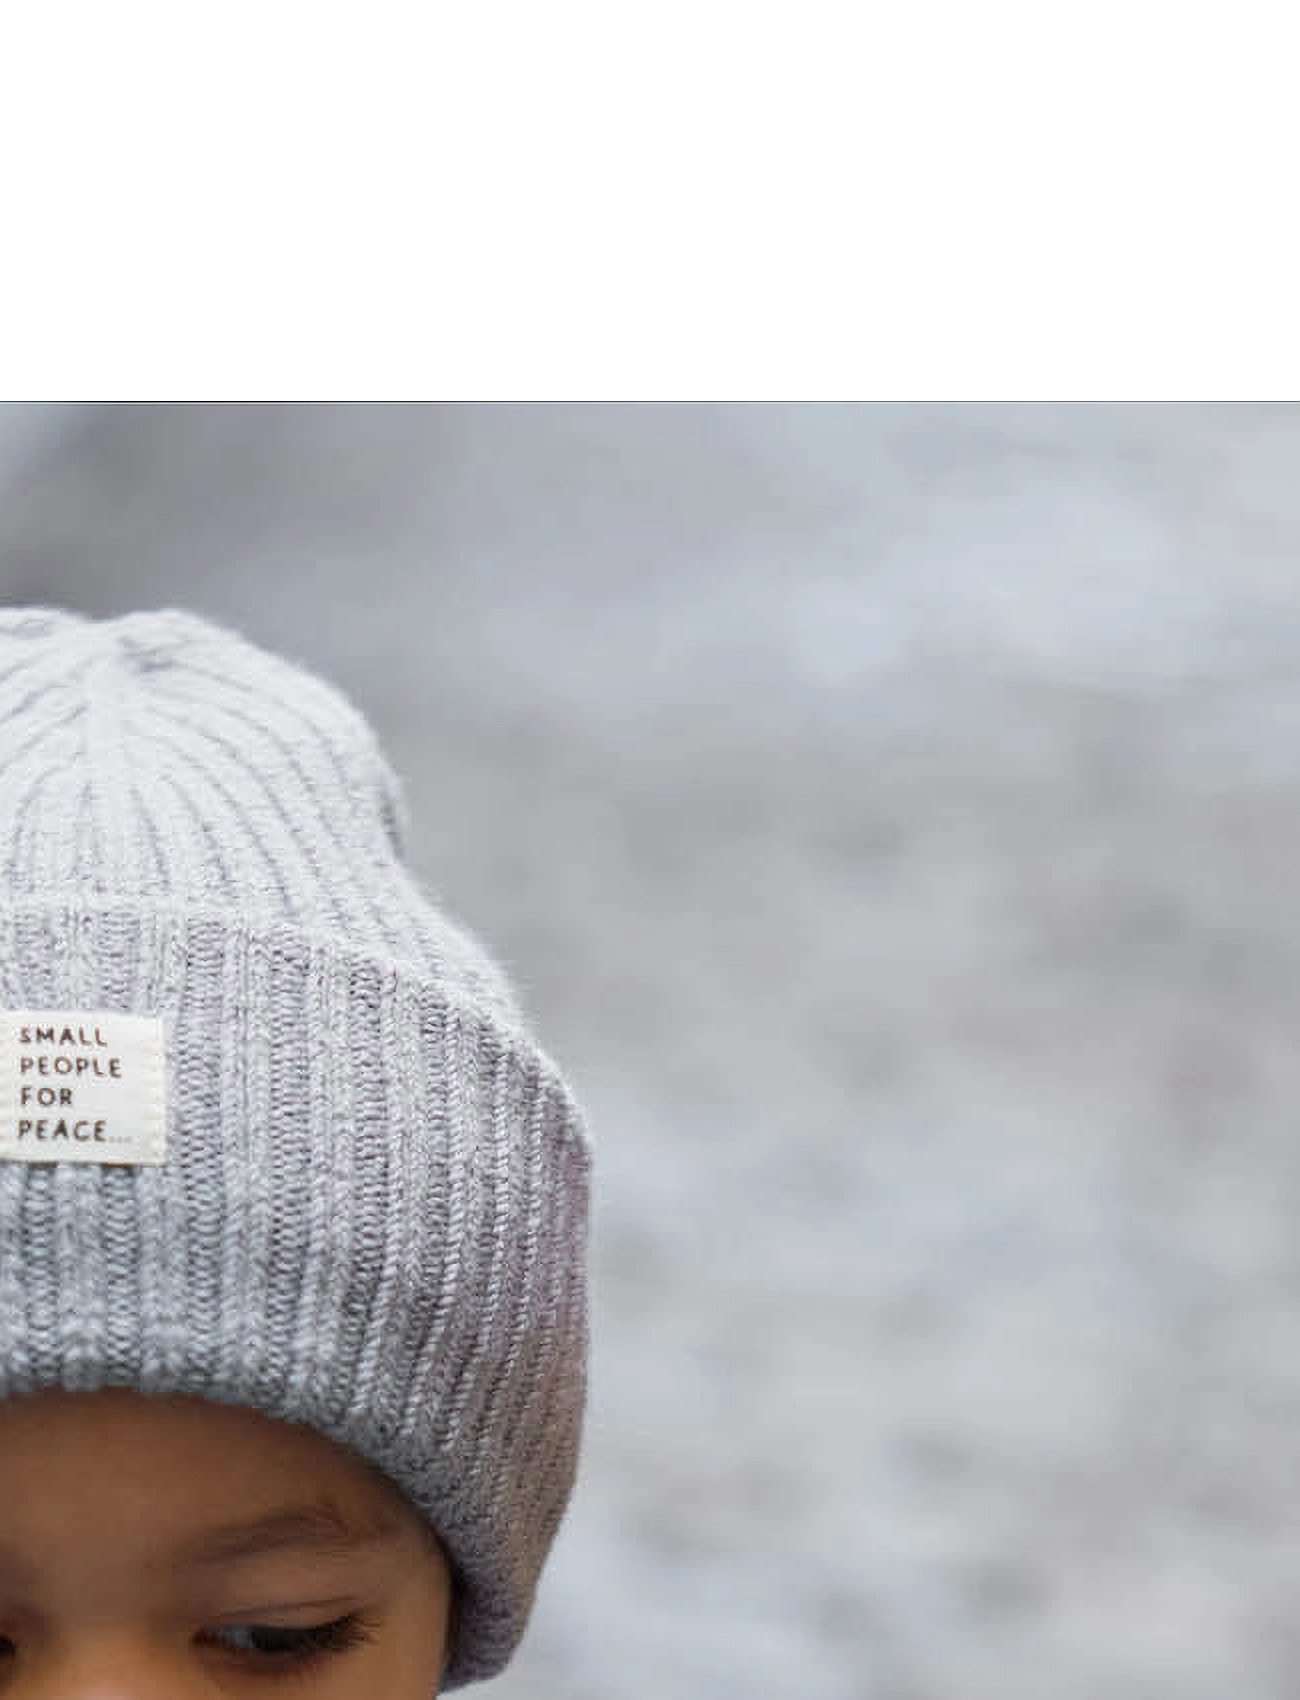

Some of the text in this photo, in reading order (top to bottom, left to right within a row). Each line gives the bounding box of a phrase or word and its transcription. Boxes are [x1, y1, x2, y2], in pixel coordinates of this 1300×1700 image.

[19, 1025, 107, 1047] SMALL
[20, 1055, 121, 1078] PEOPLE
[20, 1086, 73, 1106] FOR
